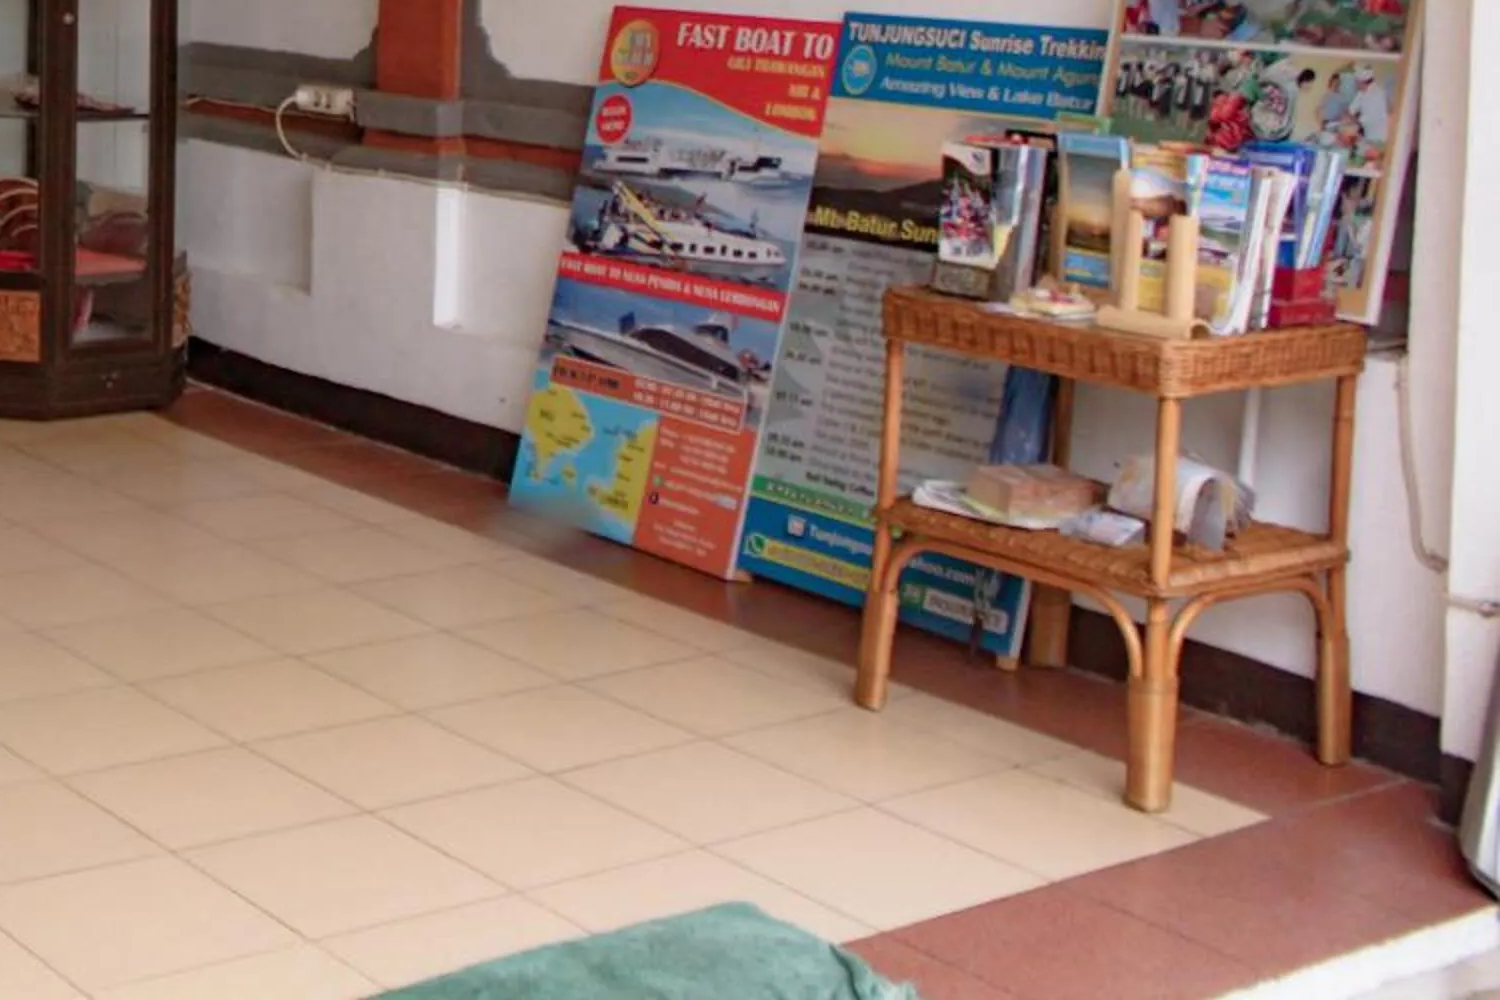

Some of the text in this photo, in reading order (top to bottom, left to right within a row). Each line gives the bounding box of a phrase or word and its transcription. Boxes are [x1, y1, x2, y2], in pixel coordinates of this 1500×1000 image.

[676, 22, 729, 50] FAST
[733, 27, 797, 57] BOAT
[802, 32, 834, 60] TO
[849, 21, 1107, 61] TUNJUNGSUCI Sunrise Trekkin
[885, 52, 932, 70] Mount
[980, 59, 992, 76] &
[998, 63, 1049, 80] Mount
[880, 76, 946, 99] Amazing
[987, 86, 1000, 101] &
[847, 210, 898, 237] Batur
